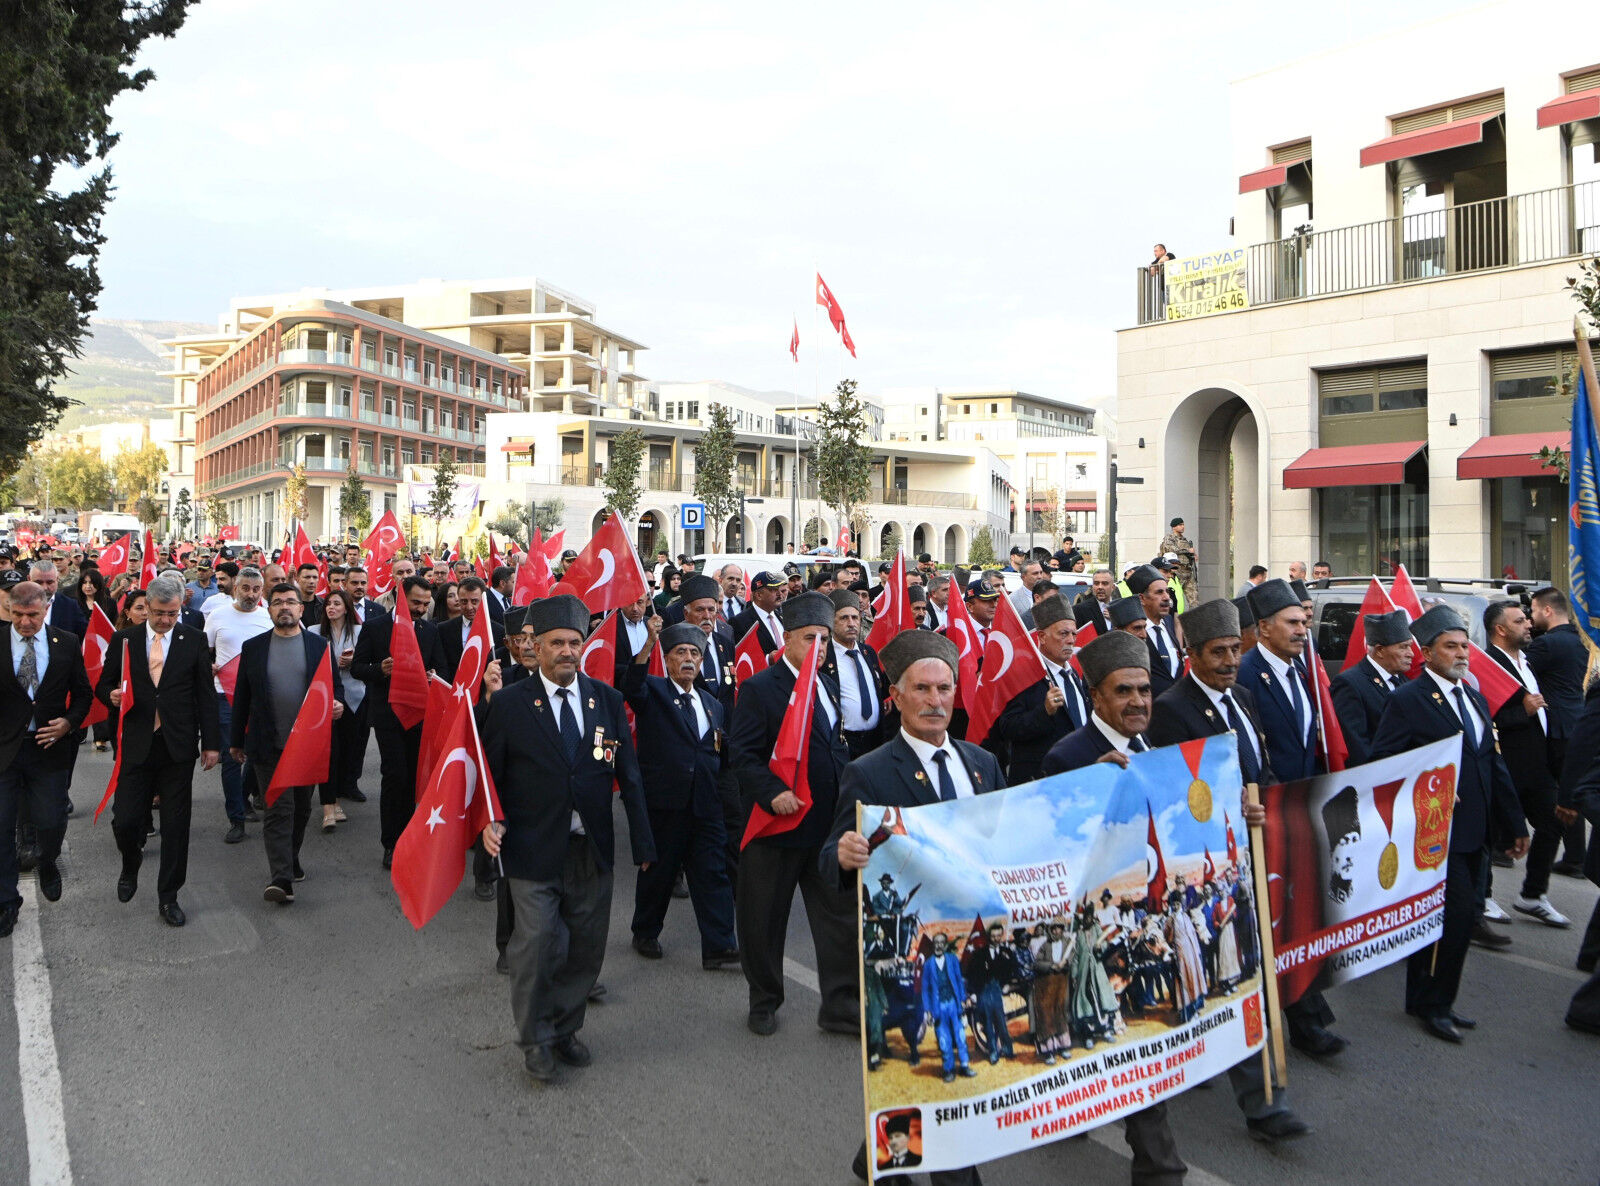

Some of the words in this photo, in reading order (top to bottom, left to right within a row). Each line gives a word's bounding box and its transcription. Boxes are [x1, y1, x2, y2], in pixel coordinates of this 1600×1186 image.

[1168, 307, 1174, 320] 0
[1214, 296, 1227, 310] 46
[1230, 293, 1244, 307] 46
[687, 509, 698, 524] D
[1011, 899, 1071, 924] KAZANDIK
[1329, 923, 1427, 972] KAHRAMANMARAŞ
[935, 1101, 969, 1126] ŞEHİT
[973, 1100, 987, 1116] VE
[991, 1086, 1031, 1111] GAZİLER
[1031, 1070, 1069, 1098] TOPRAĞI
[1070, 1060, 1103, 1083] VATAN,
[1103, 1047, 1137, 1070] İNSANI
[1139, 1041, 1163, 1059] ULUS
[1165, 1031, 1191, 1050] YAPAN
[996, 1100, 1054, 1130] TÜRKİYE
[1055, 1078, 1108, 1111] MUHARİP
[1111, 1061, 1163, 1089] GAZİLER
[1165, 1038, 1207, 1070] DERNEĞİ
[1031, 1088, 1145, 1140] KAHRAMANMARAŞ
[1148, 1068, 1186, 1101] ŞUBESİ
